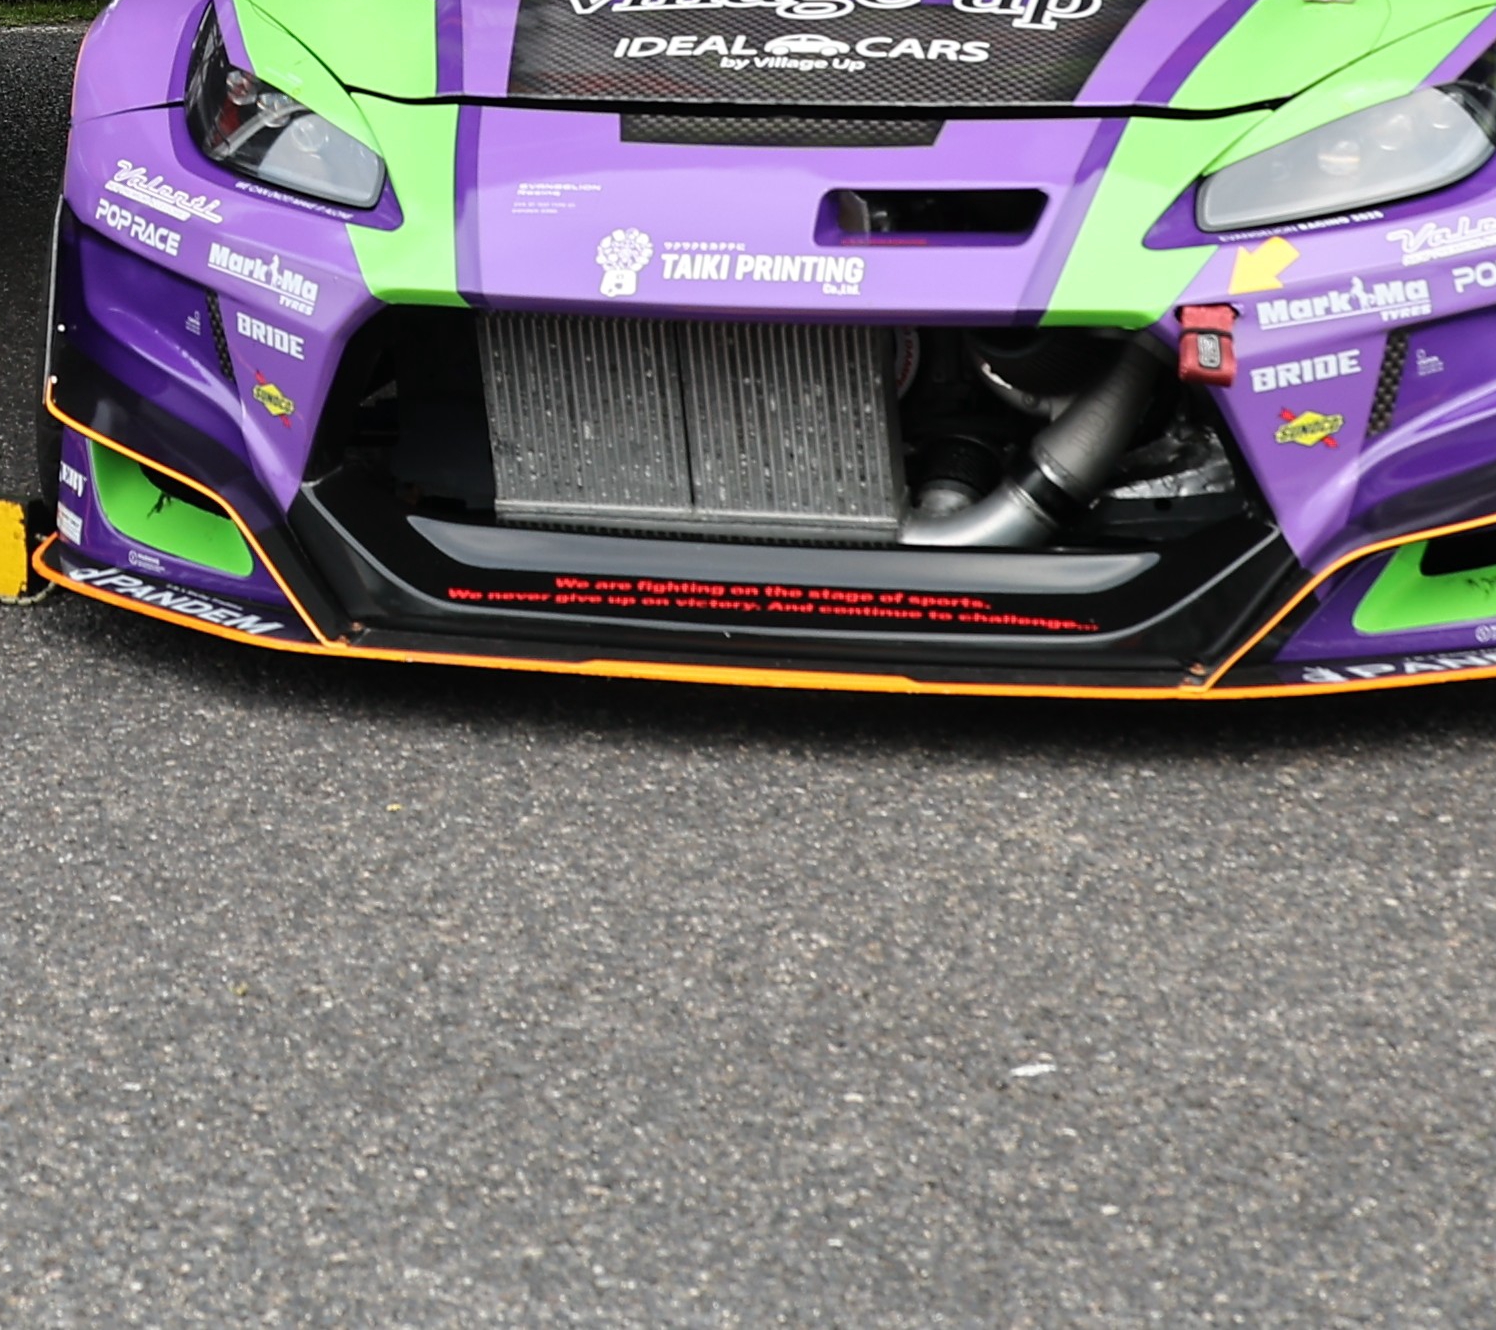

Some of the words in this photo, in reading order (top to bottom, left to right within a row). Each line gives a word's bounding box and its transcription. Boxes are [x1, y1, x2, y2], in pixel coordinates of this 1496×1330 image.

[612, 36, 758, 59] IDEAL
[854, 36, 991, 64] CARS
[719, 56, 750, 72] by
[753, 54, 828, 72] Village
[832, 58, 866, 73] Up
[95, 197, 134, 237] POP
[129, 213, 181, 257] RACE
[208, 241, 268, 283] Mark
[280, 270, 320, 302] Ma
[661, 252, 731, 281] TAIKI
[734, 254, 865, 284] PRINTING
[278, 293, 315, 317] TYRES
[1256, 287, 1352, 329] Mark
[1372, 278, 1431, 308] Ma
[1380, 305, 1433, 322] TYRES
[236, 310, 306, 361] BRIDE
[1249, 349, 1362, 394] BRIDE
[253, 385, 296, 418] SUNOCO
[1274, 413, 1344, 446] SUNOCO
[447, 587, 483, 600] We
[487, 591, 549, 601] never
[554, 593, 603, 605] give
[606, 595, 637, 607] up
[640, 597, 670, 607] on
[674, 598, 762, 613] victory.
[768, 599, 815, 613] And
[819, 605, 923, 619] continue
[927, 610, 954, 621] to
[555, 577, 590, 591] We
[594, 580, 632, 591] are
[636, 579, 725, 597] fighting
[729, 585, 759, 597] on
[763, 585, 803, 598] the
[807, 588, 875, 603] stage
[879, 590, 904, 603] of
[908, 595, 991, 610] sports.
